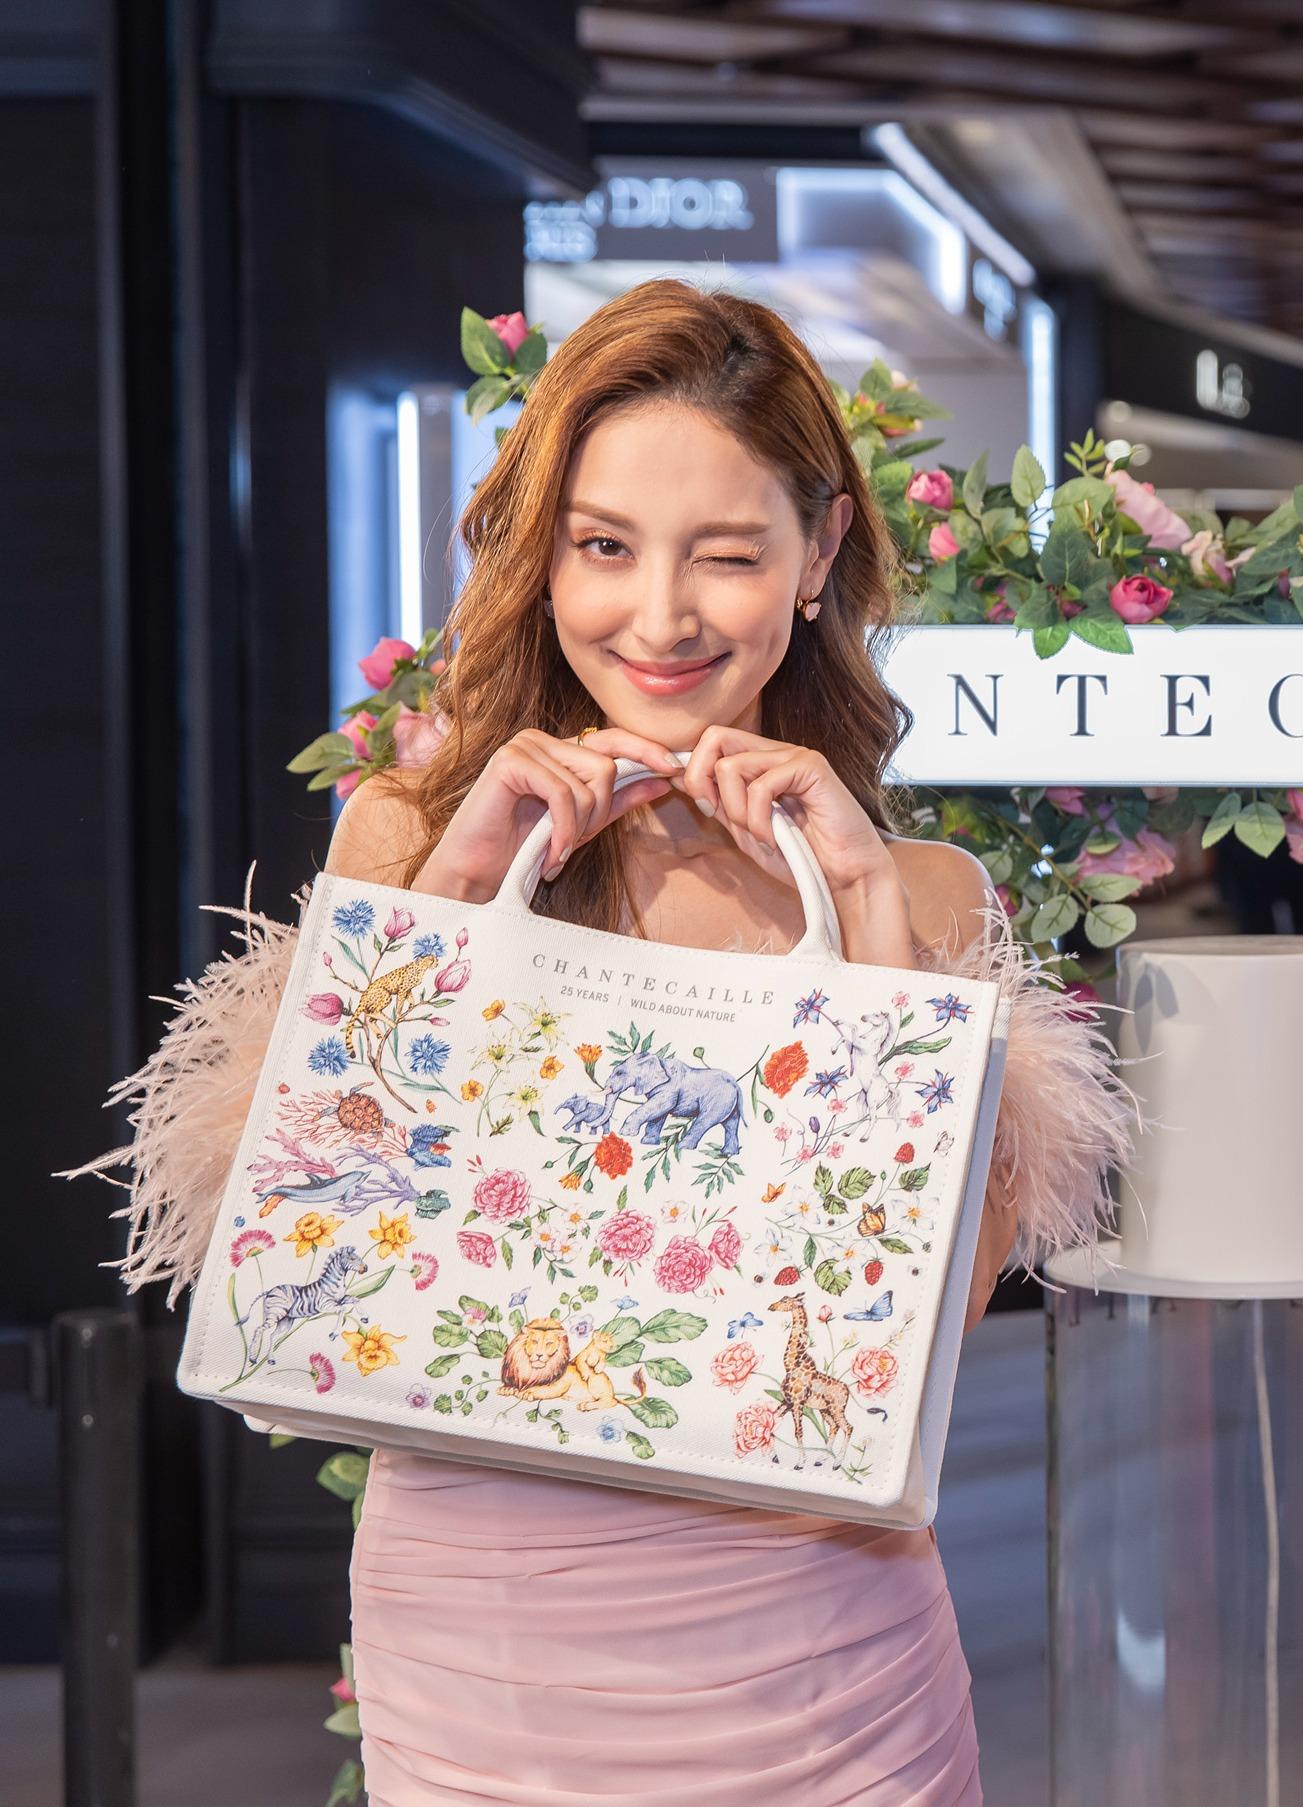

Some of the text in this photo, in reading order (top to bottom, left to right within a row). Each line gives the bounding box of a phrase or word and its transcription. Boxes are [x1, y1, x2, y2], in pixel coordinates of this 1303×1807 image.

[609, 178, 753, 229] DIOR
[531, 953, 775, 1005] CHANTECAILLE
[560, 985, 736, 1023] 25 YEARS WILD ABOUT NATURE
